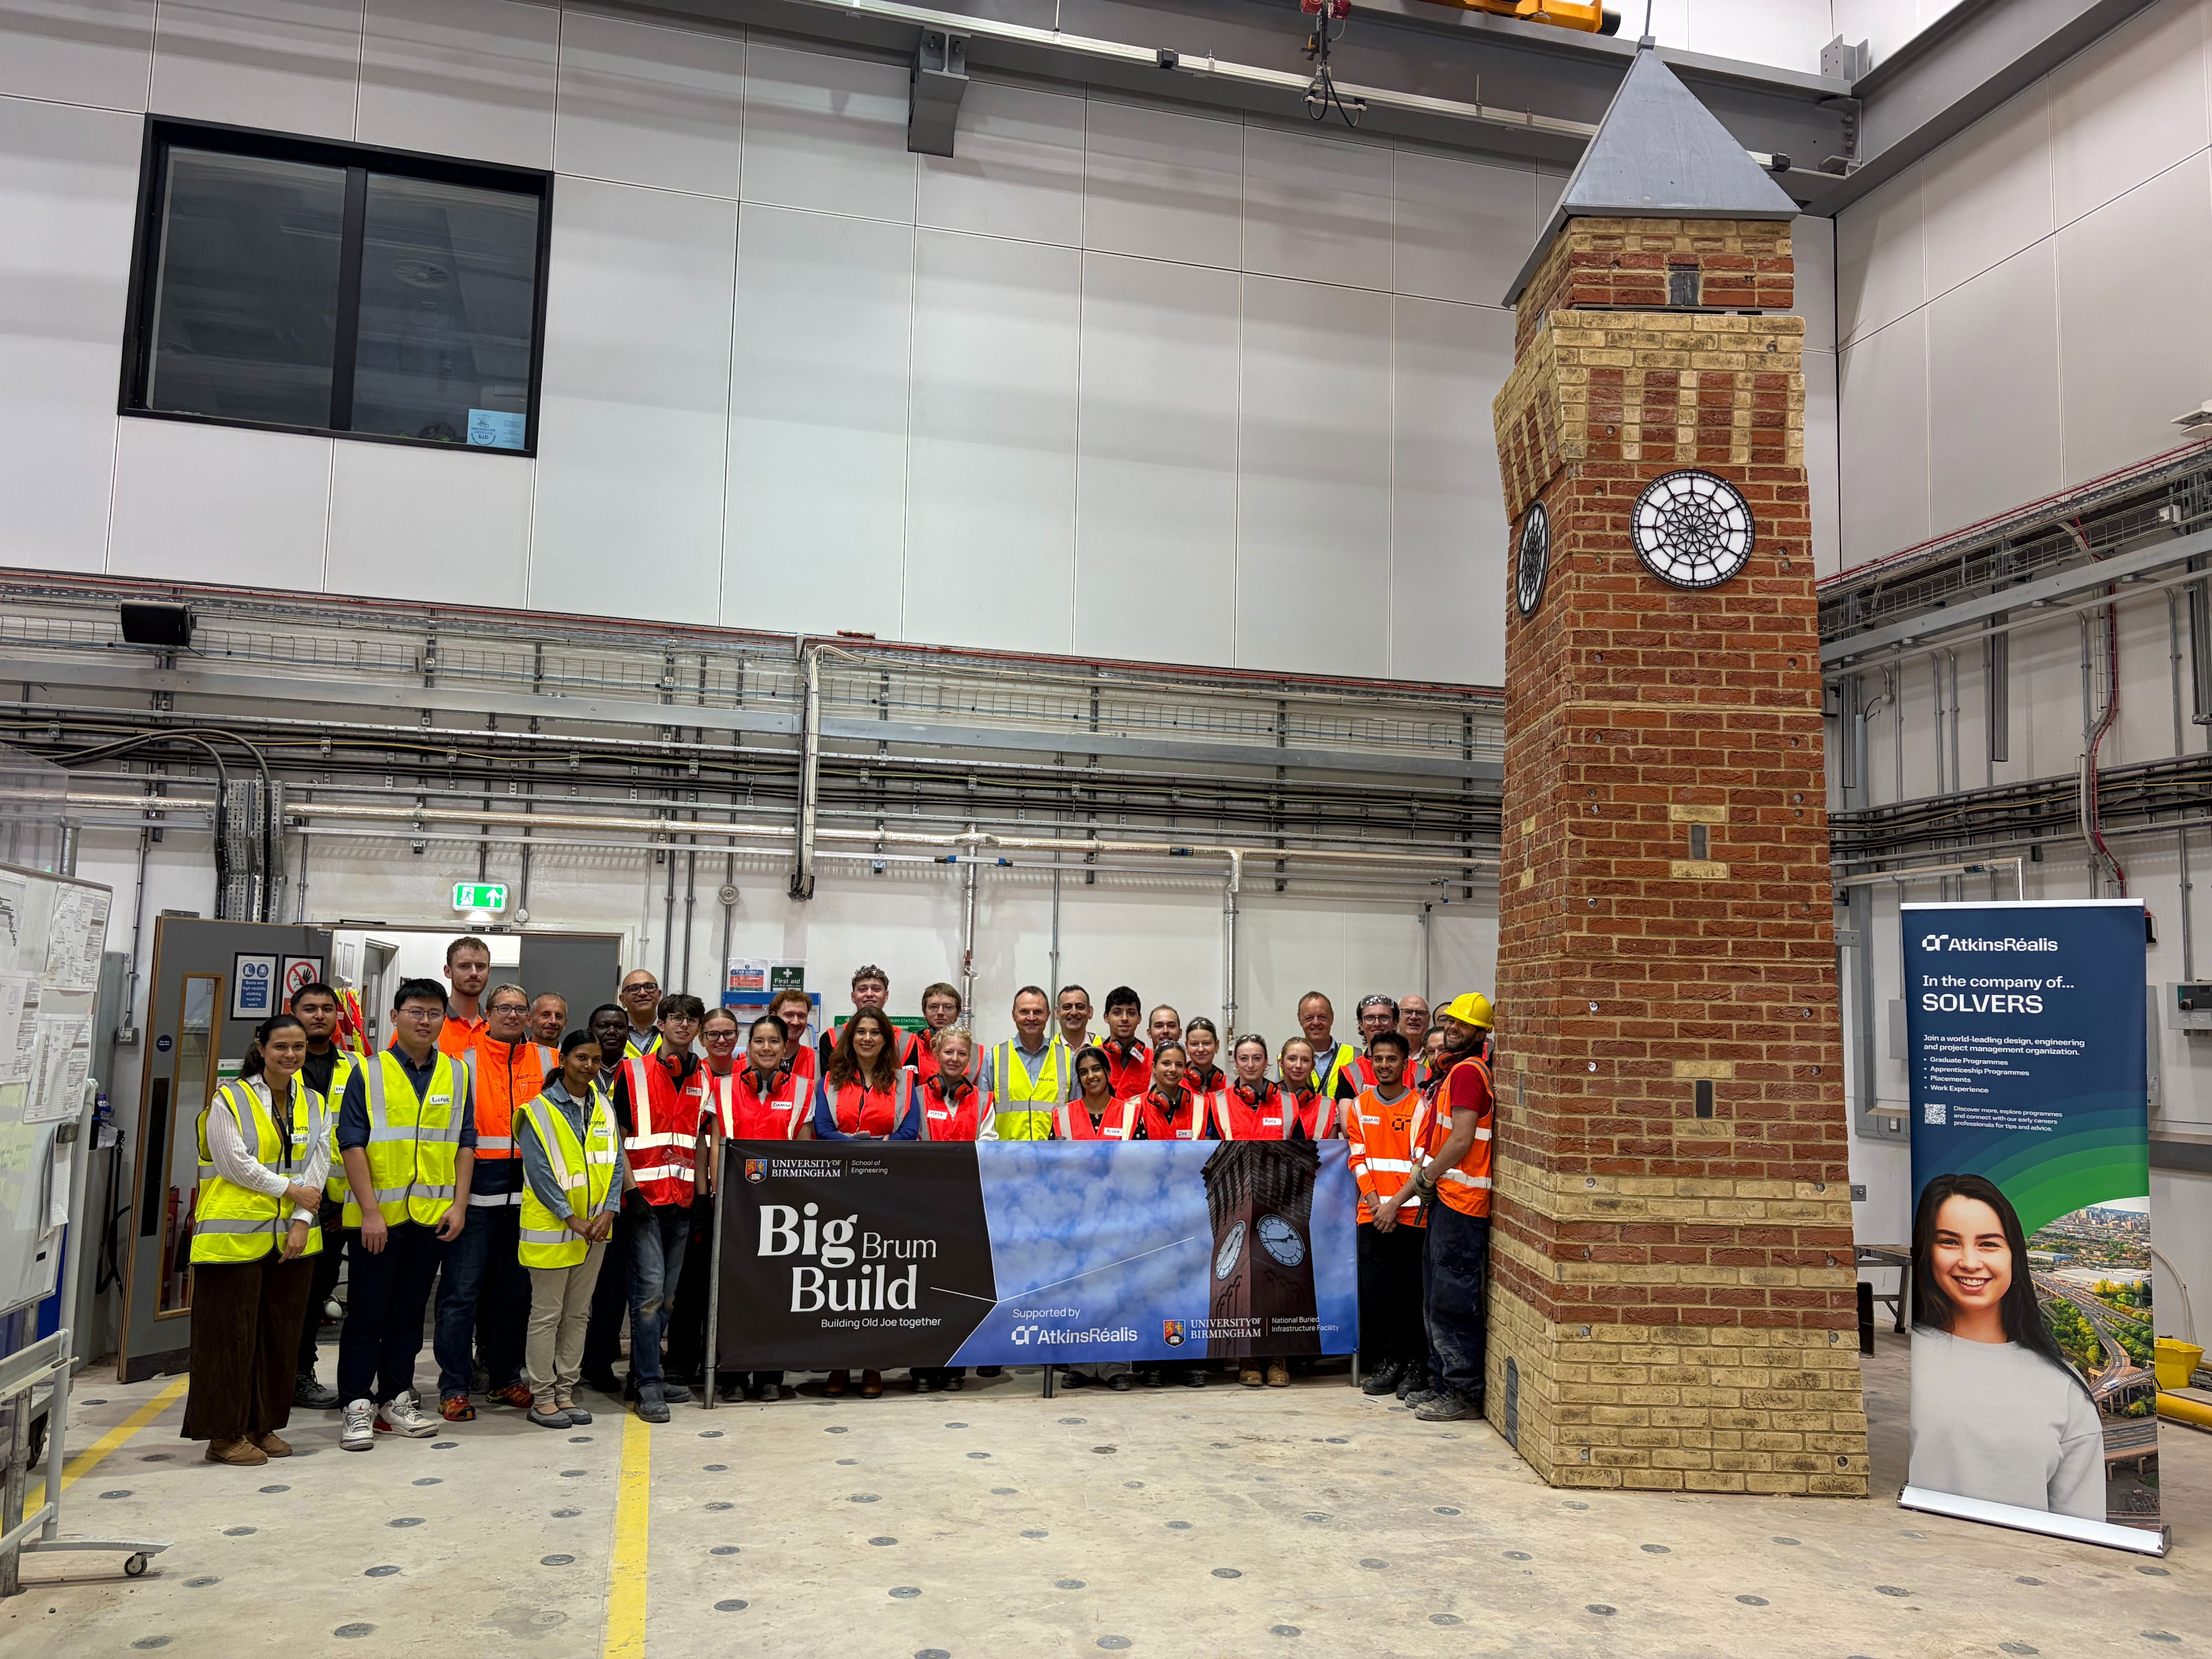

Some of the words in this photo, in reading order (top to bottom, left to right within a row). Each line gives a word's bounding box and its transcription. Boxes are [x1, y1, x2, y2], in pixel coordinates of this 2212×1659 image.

[1948, 938, 2059, 952] AtkinsRéalis
[1922, 975, 1938, 987] In
[1941, 975, 1967, 987] the
[1970, 977, 2042, 991] company
[2046, 976, 2075, 988] of...
[1922, 993, 2043, 1014] SOLVERS
[1946, 1035, 2003, 1045] world-leading
[2004, 1037, 2033, 1045] design,
[2035, 1039, 2085, 1048] engineering
[1969, 1045, 2024, 1054] management
[1963, 1058, 2008, 1066] Programmes
[1930, 1065, 1983, 1075] Apprenticeship
[1984, 1068, 2030, 1076] Programmes
[1949, 1085, 1989, 1093] Experience
[772, 1169, 841, 1177] BIRMINGHAM
[757, 1202, 859, 1268] Big
[862, 1232, 937, 1258] Brum
[790, 1264, 918, 1312] Build
[1013, 1307, 1066, 1320] Supported
[1068, 1306, 1081, 1319] by
[821, 1319, 860, 1329] Building
[861, 1318, 878, 1327] Old
[880, 1318, 898, 1327] Joe
[899, 1317, 942, 1329] together
[1191, 1318, 1251, 1328] UNIVERSITY
[1317, 1324, 1339, 1332] Facility
[1037, 1327, 1138, 1345] AtkinsRéalis
[1190, 1329, 1262, 1339] BIRMINGHAM
